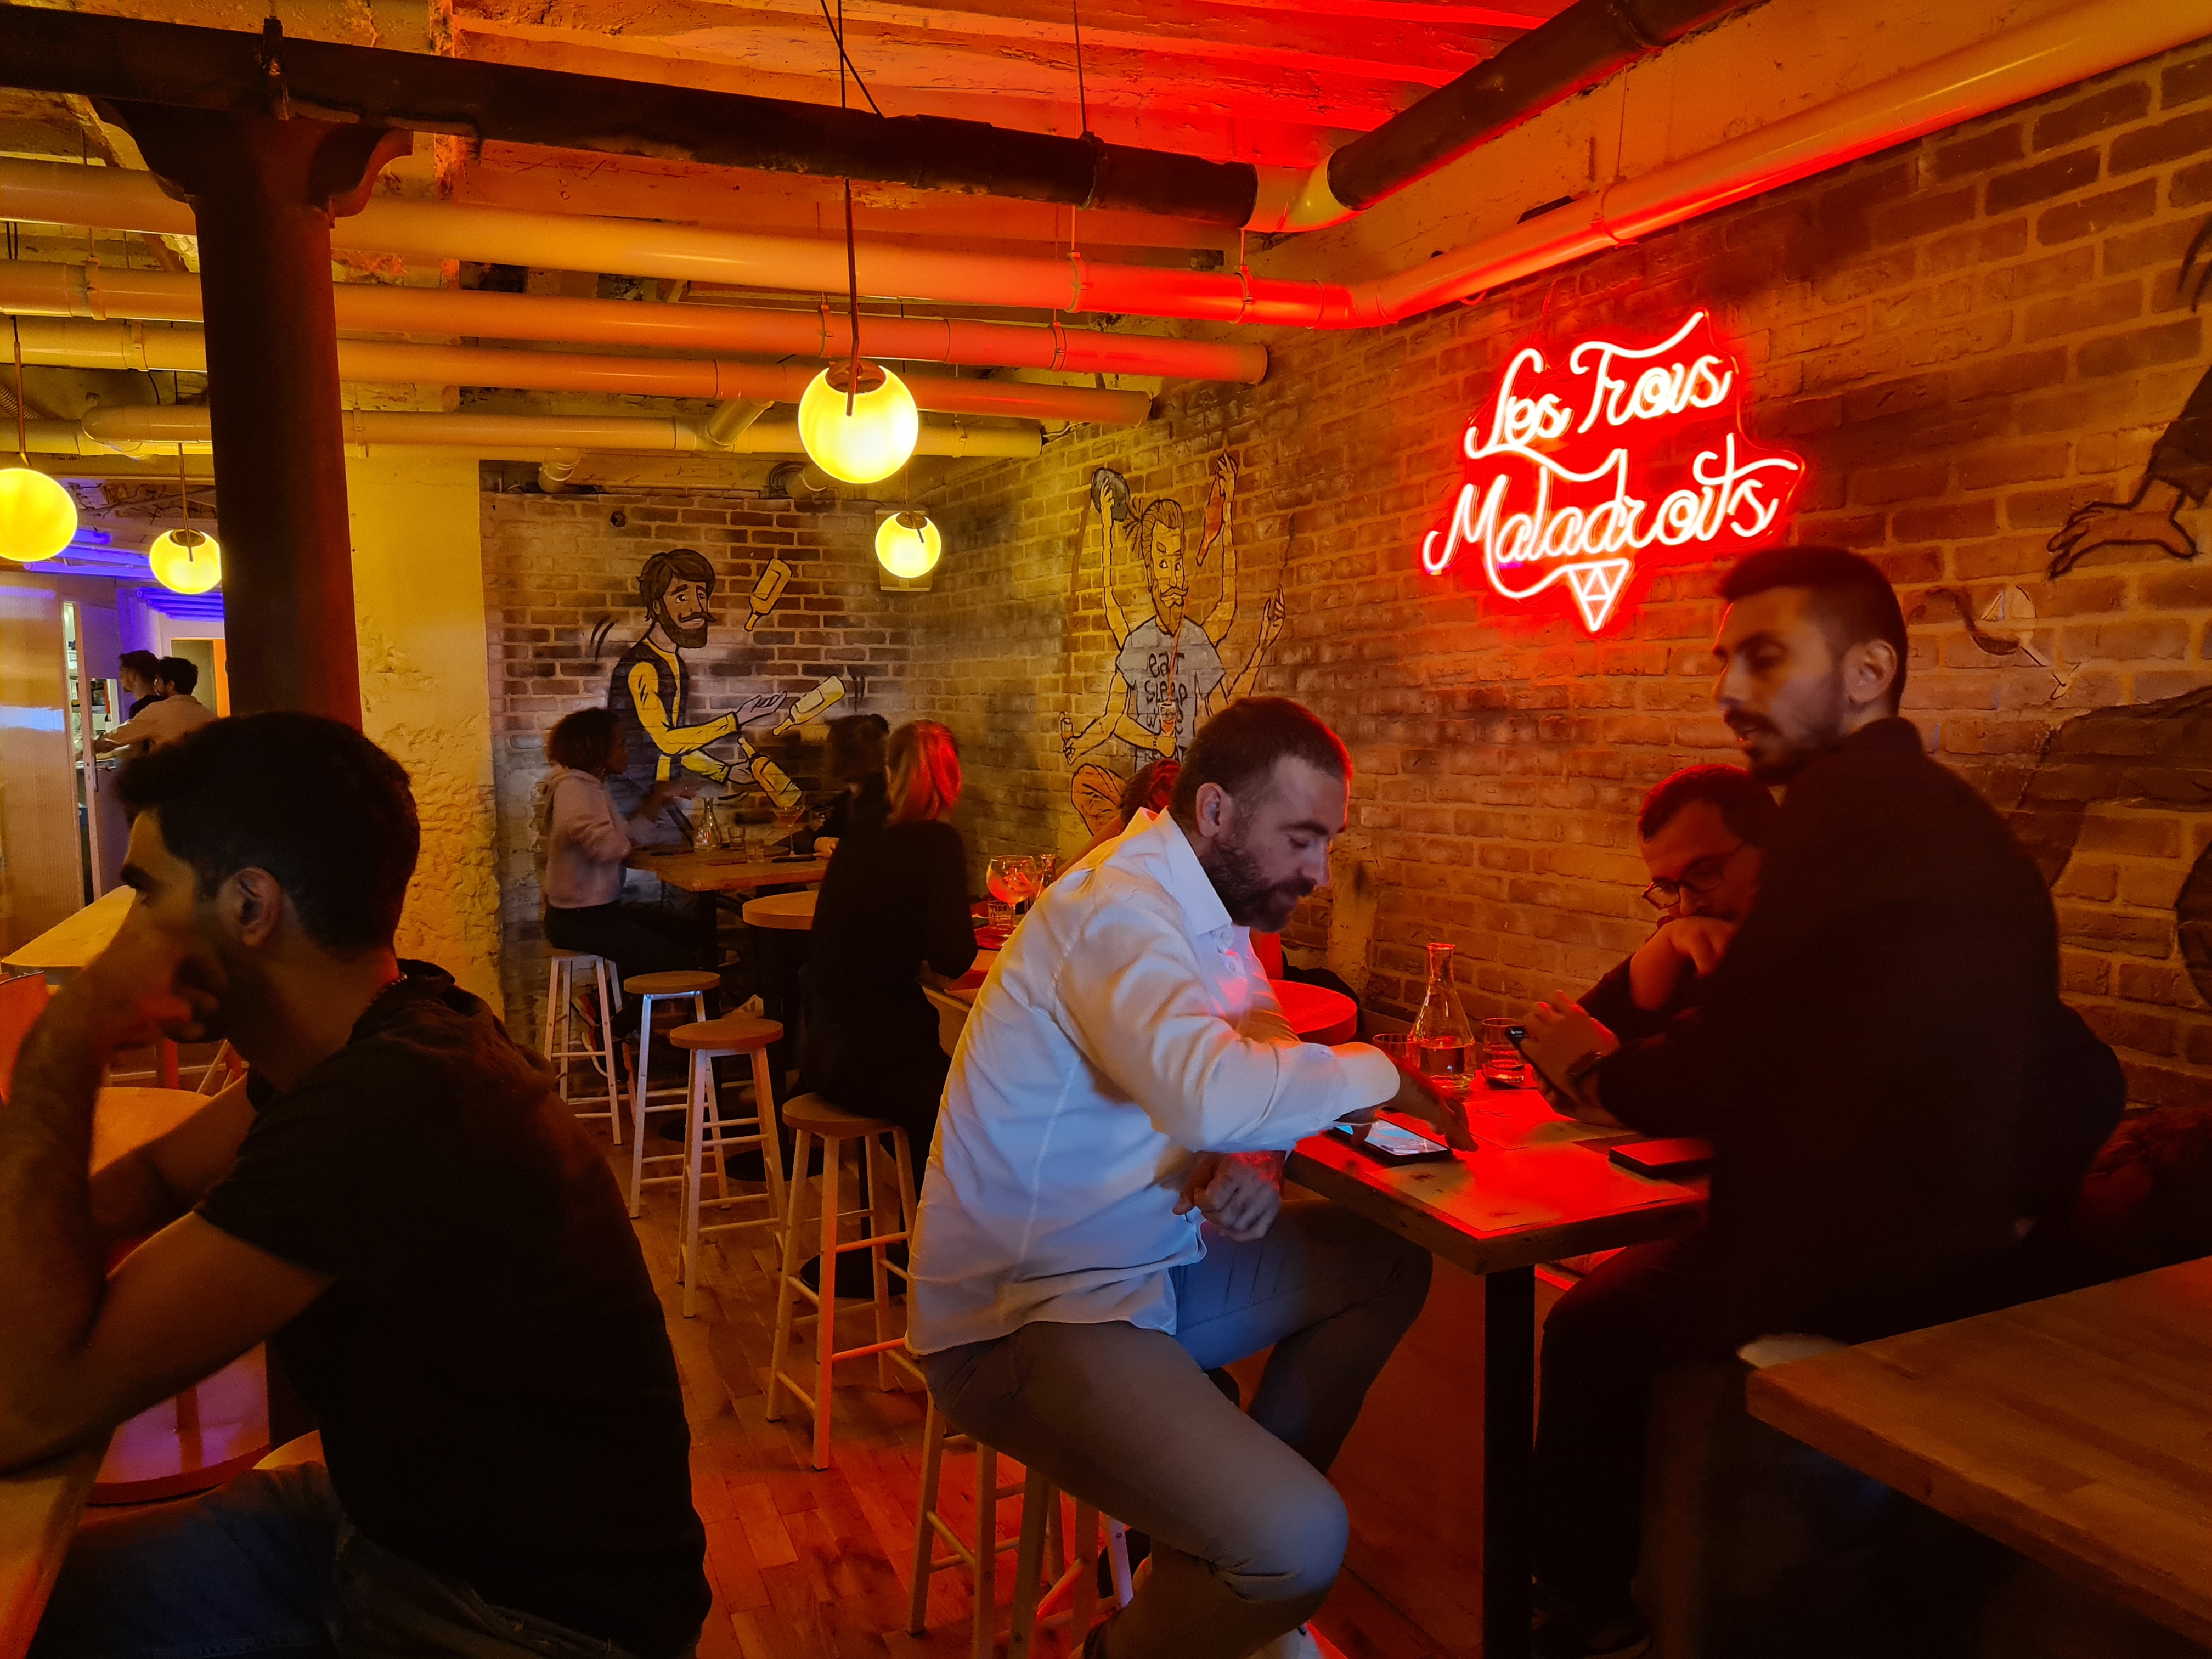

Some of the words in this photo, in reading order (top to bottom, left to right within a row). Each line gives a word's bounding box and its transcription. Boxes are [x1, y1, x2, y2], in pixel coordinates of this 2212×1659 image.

[1465, 348, 1575, 459] Les
[1570, 311, 1733, 435] Trois
[1423, 432, 1799, 599] Maladroits
